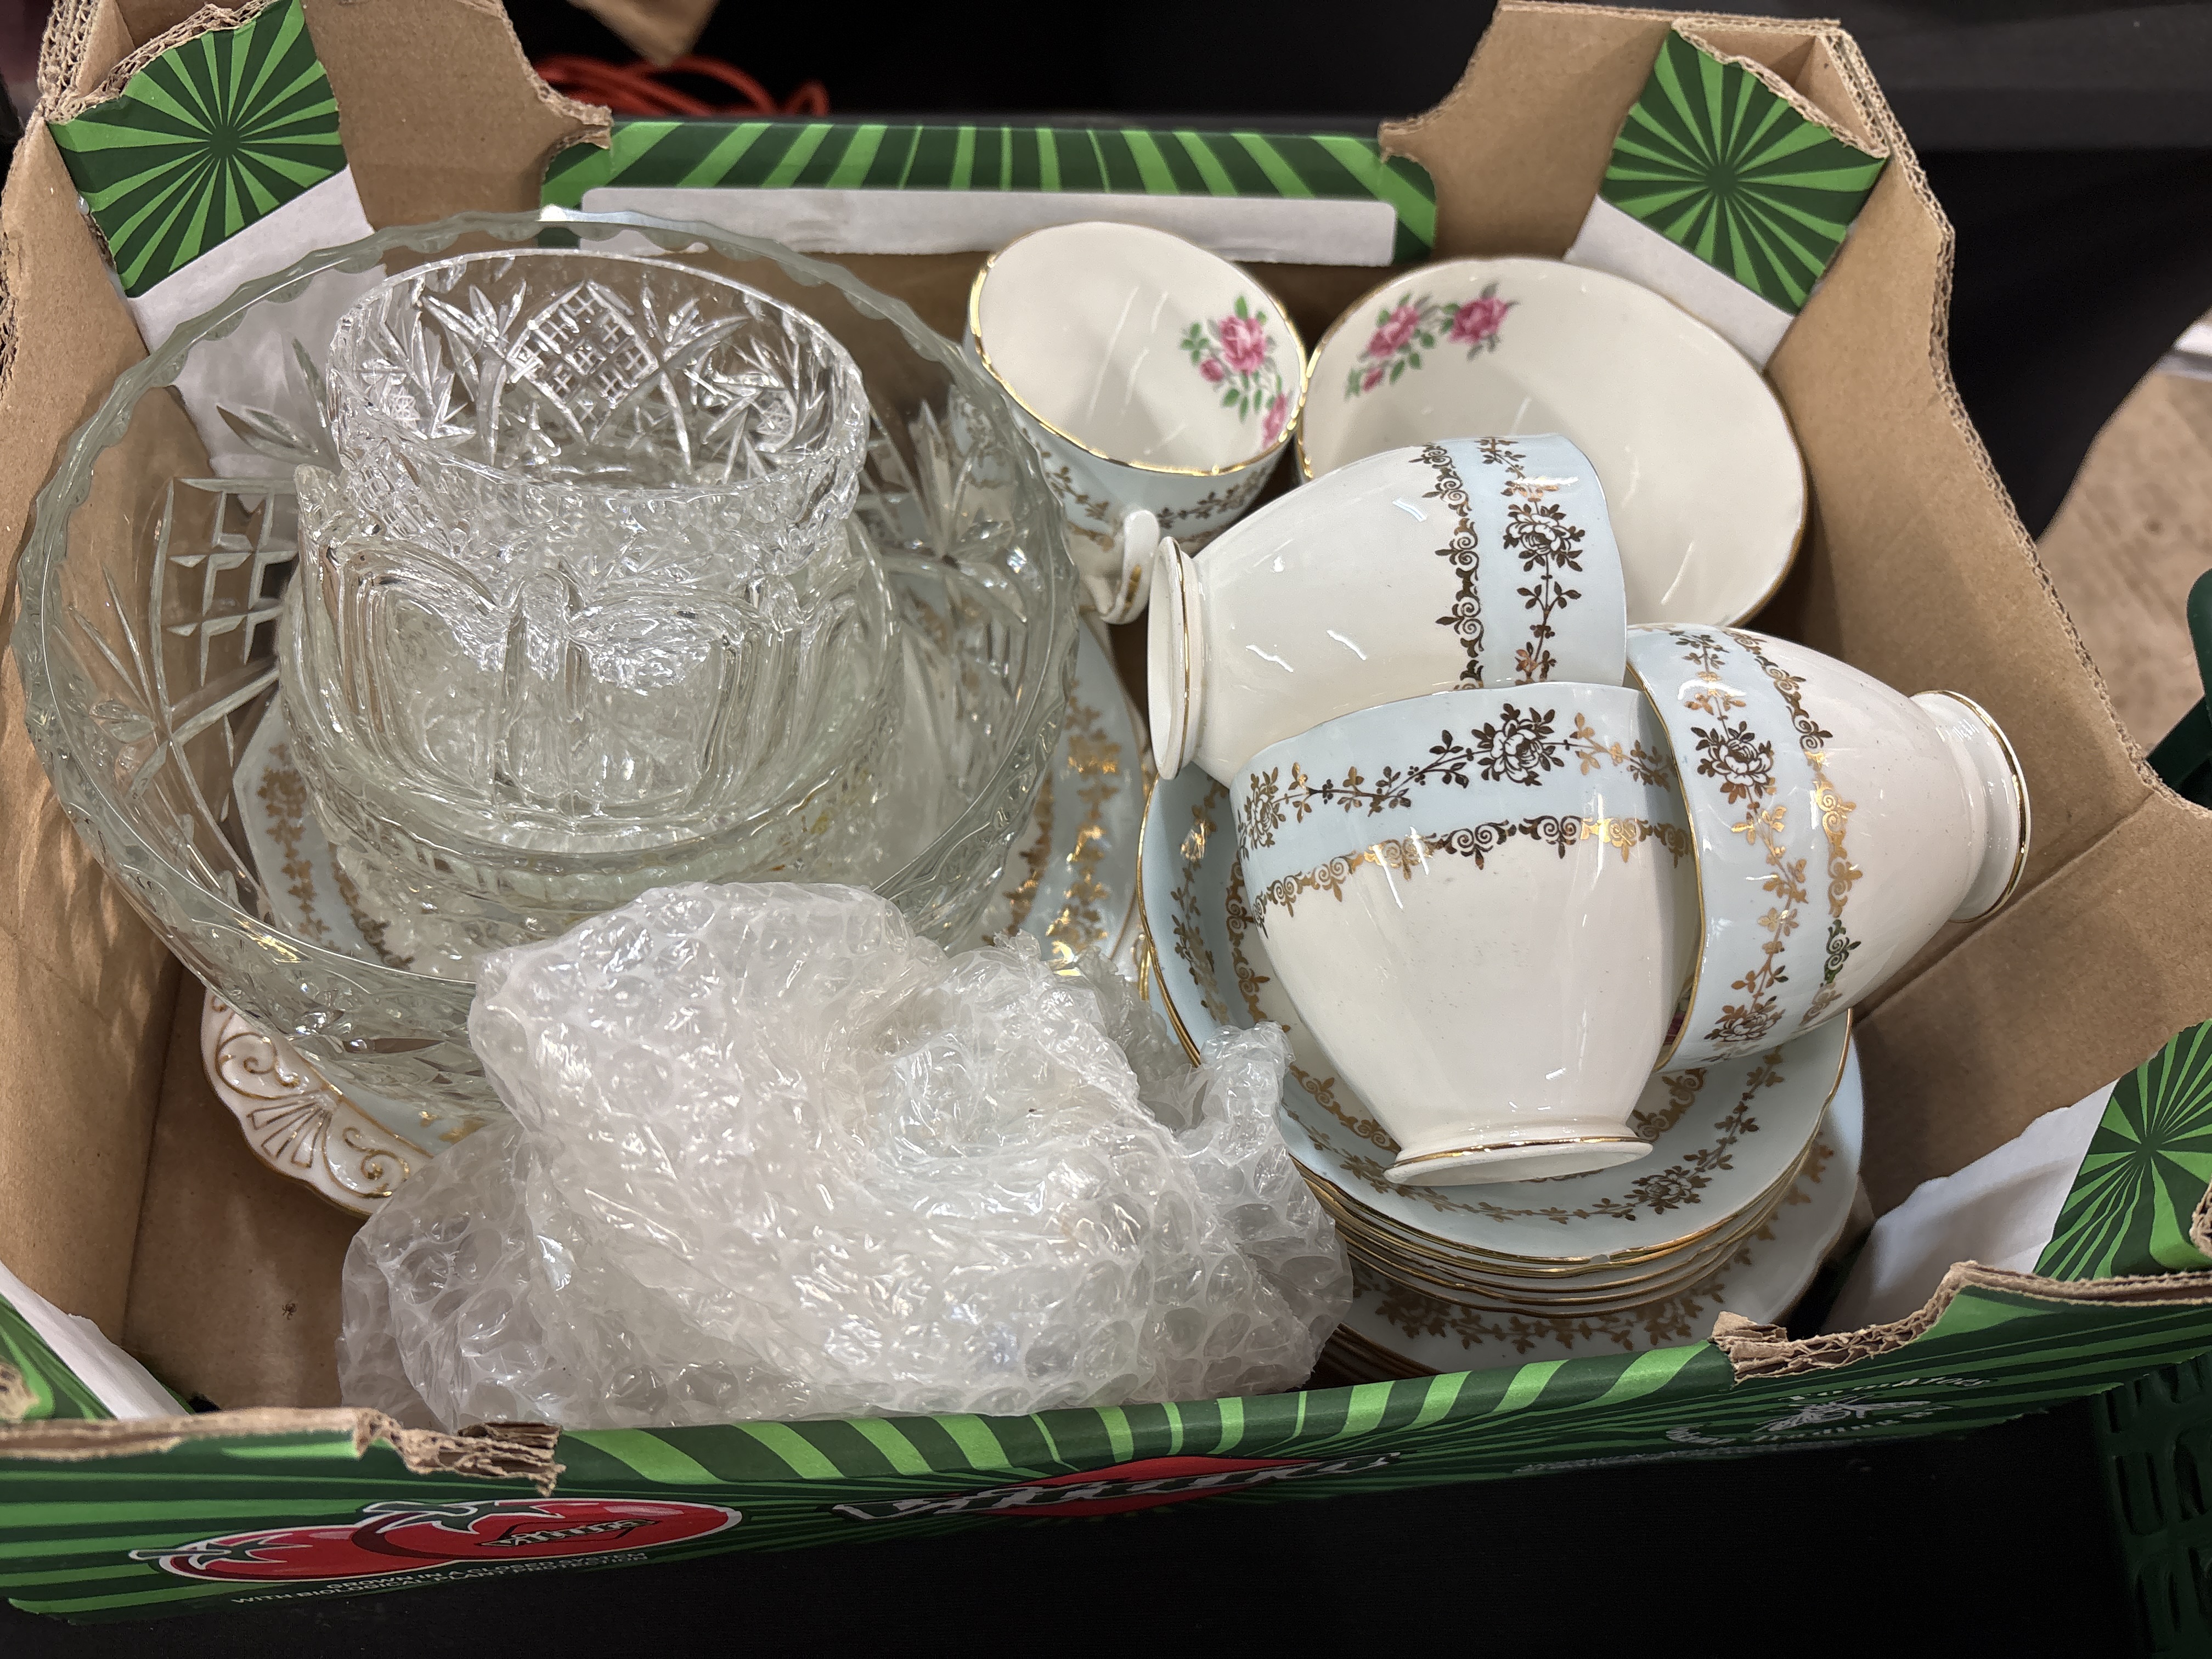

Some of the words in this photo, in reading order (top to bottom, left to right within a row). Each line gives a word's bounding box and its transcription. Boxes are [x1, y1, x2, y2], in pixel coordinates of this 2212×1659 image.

[230, 1593, 294, 1604] WITH
[296, 1578, 427, 1598] BIOLOGICAL
[433, 1570, 506, 1583] PLANT
[326, 1575, 414, 1589] GROWN
